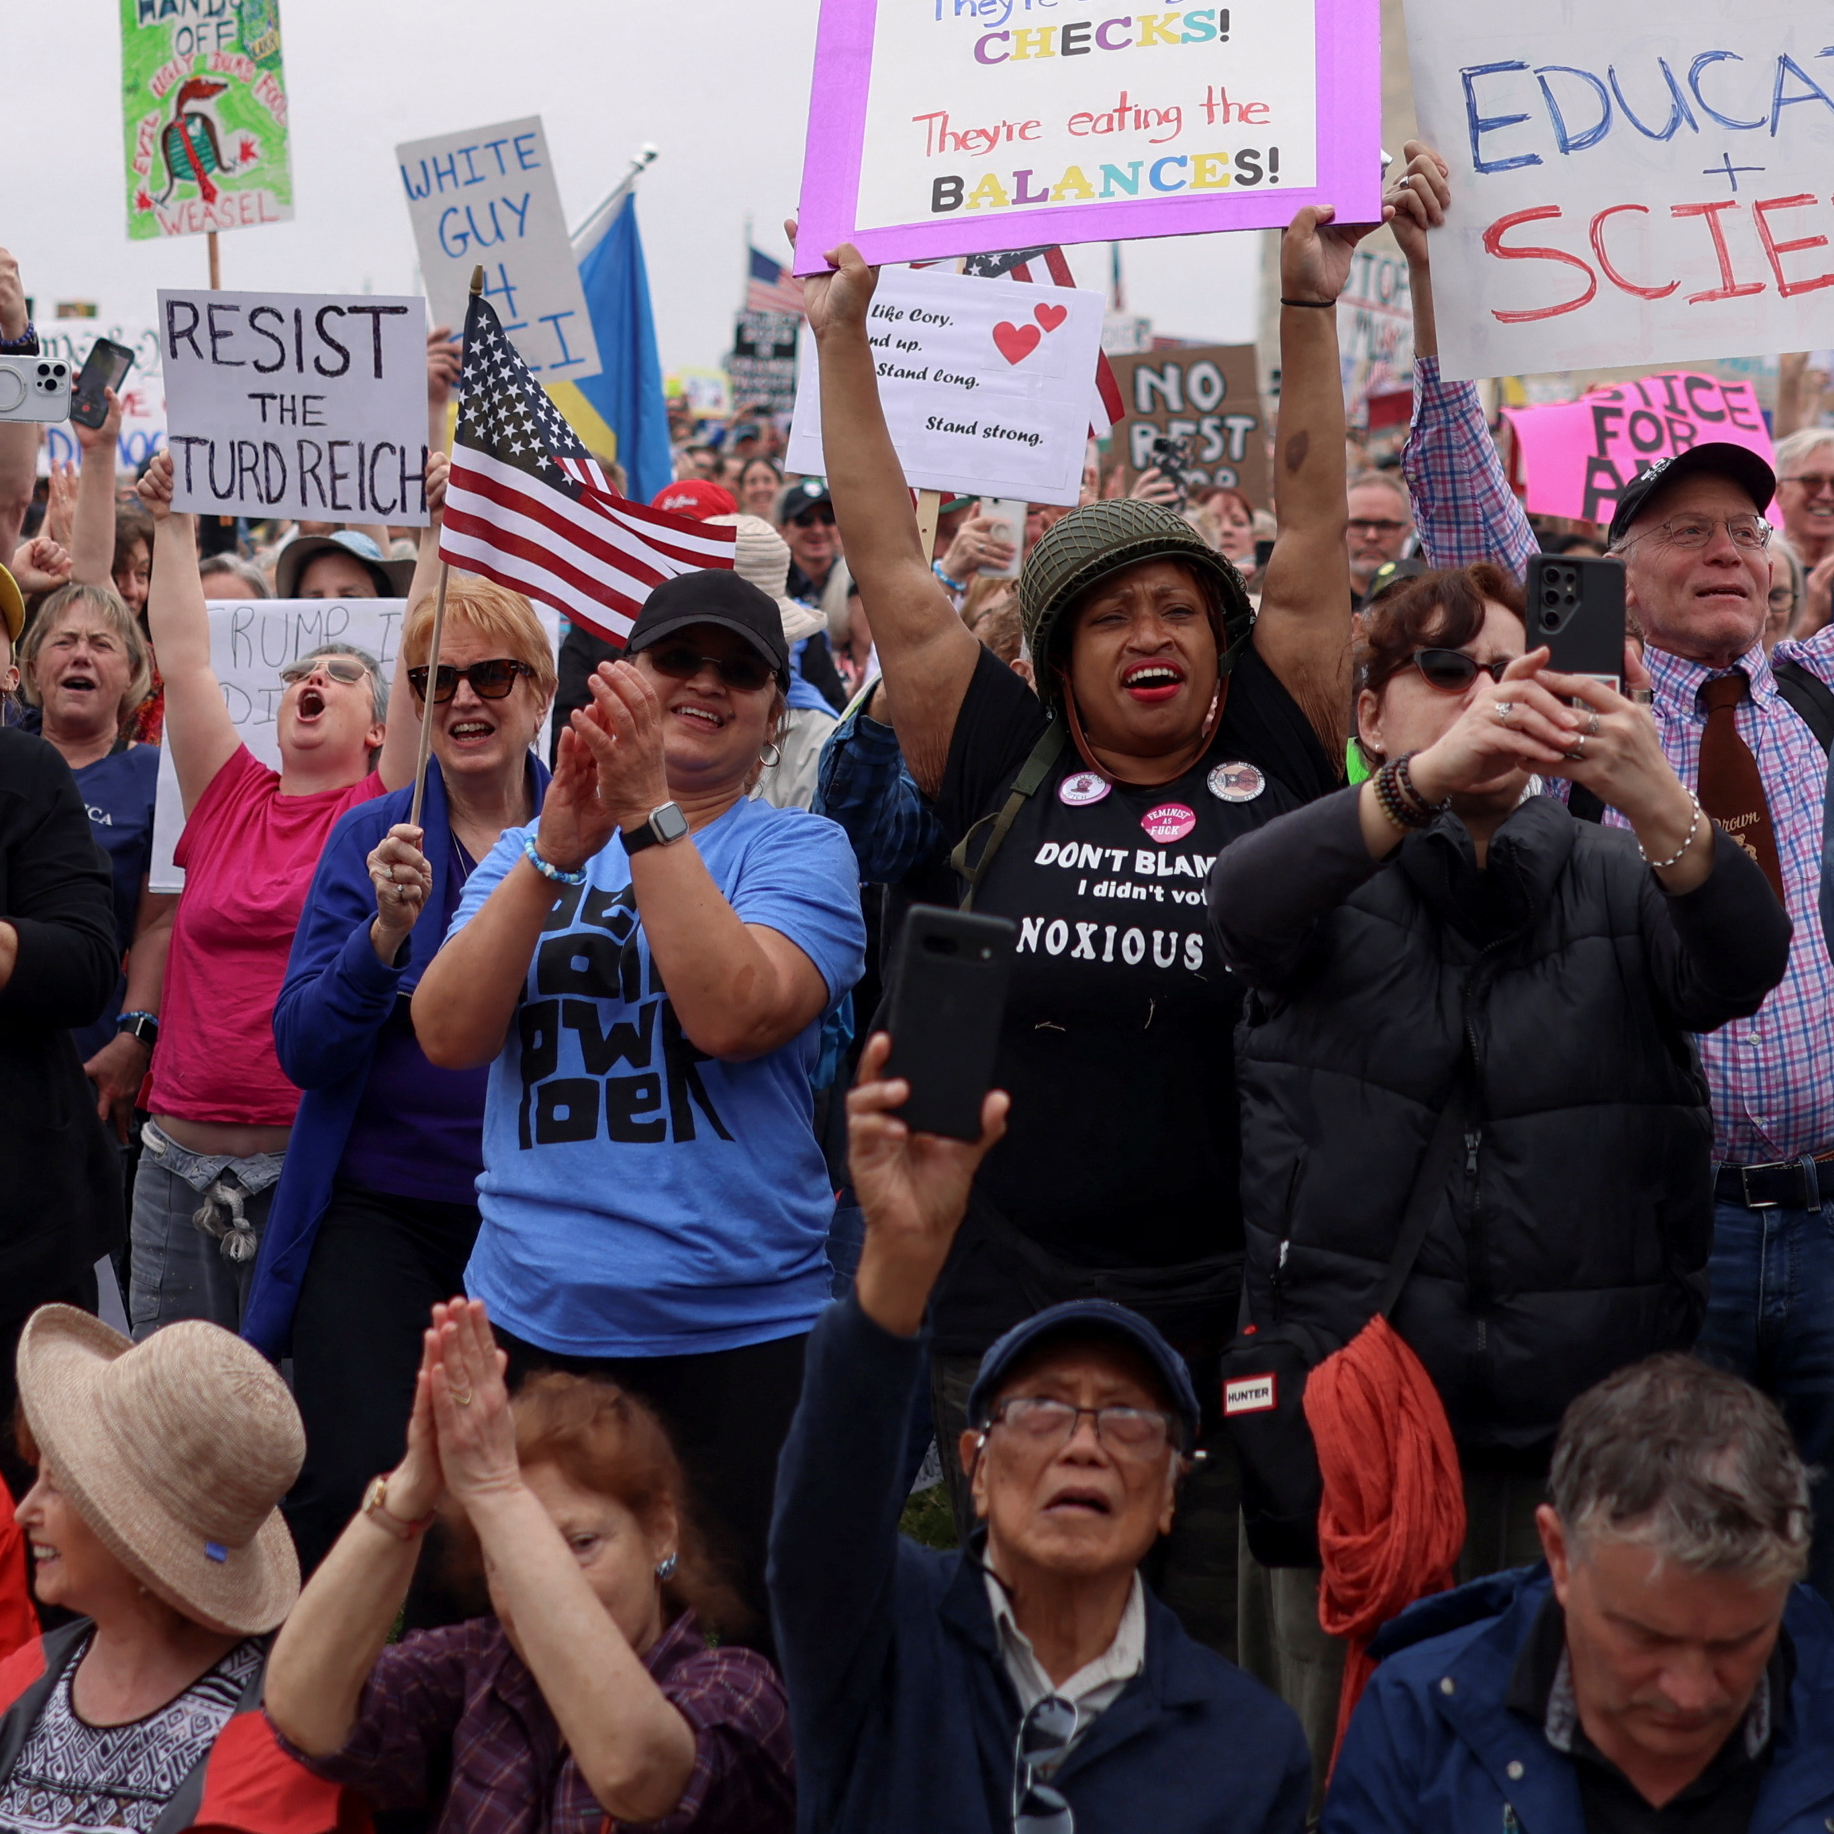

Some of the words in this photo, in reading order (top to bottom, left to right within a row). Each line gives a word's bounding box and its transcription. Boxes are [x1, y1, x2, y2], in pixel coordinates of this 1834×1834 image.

[175, 20, 235, 56] OFF
[974, 8, 1230, 65] CHECKS!
[151, 52, 195, 98] UGLY
[254, 70, 288, 127] FOOL
[132, 113, 161, 176] EVIL
[912, 110, 1043, 157] They're
[1067, 91, 1183, 144] eating
[1199, 85, 1272, 126] the
[400, 132, 542, 202] WHITE
[931, 146, 1280, 213] BALANCES!
[156, 193, 279, 237] WEASEL
[438, 192, 531, 259] GUY
[482, 263, 517, 318] 4
[166, 299, 409, 379] RESIST
[909, 308, 954, 327] Cory.
[896, 338, 923, 353] up.
[876, 362, 928, 382] Stand
[934, 369, 981, 390] long.
[1133, 360, 1227, 413] NO
[247, 392, 328, 427] THE
[925, 416, 979, 436] Stand
[982, 424, 1045, 447] strong.
[1591, 405, 1698, 458] FOR
[169, 435, 288, 504] TURD
[297, 439, 429, 516] REICH
[1147, 807, 1191, 821] FEMINIST
[1150, 825, 1180, 836] FUCK
[1162, 817, 1173, 825] AS
[1034, 841, 1128, 872] DON'T
[1077, 879, 1088, 896] I
[1093, 881, 1165, 903] didn't
[1016, 917, 1204, 971] NOXIOUS
[1228, 1387, 1270, 1403] HUNTER
